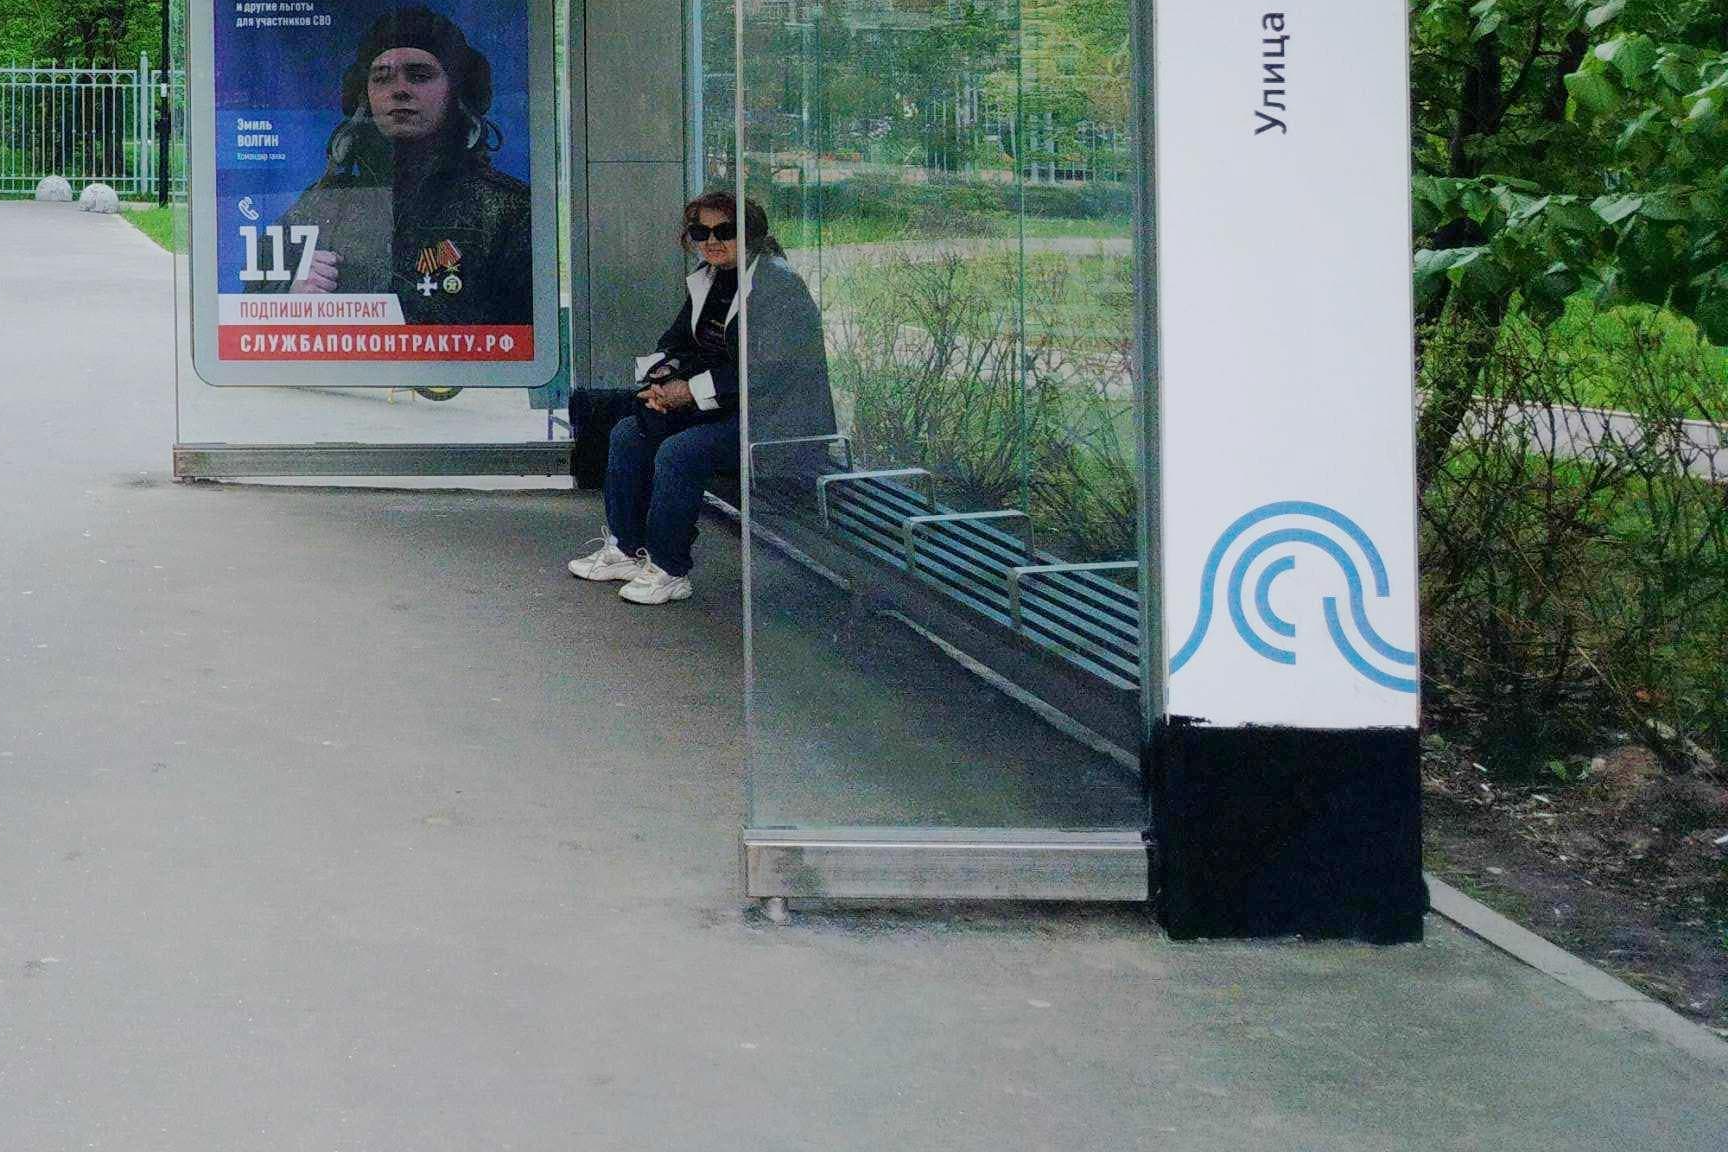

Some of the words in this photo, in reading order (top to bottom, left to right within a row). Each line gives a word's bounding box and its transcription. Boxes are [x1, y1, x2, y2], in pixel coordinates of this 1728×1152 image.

[236, 2, 243, 11] и
[244, 1, 278, 15] другие
[279, 0, 314, 13] льготы
[236, 17, 254, 28] для
[255, 16, 312, 29] участников
[313, 15, 332, 26] СВО
[1254, 12, 1290, 135] Улица
[237, 118, 272, 130] Эмиль
[237, 134, 279, 147] ВОЛГИН
[239, 226, 319, 281] 117
[240, 301, 313, 320] ПОДПИШИ
[318, 300, 388, 319] КОНТРАКТ
[240, 334, 514, 352] СЛУЖБАПОКОНТРАКТУ.РФ
